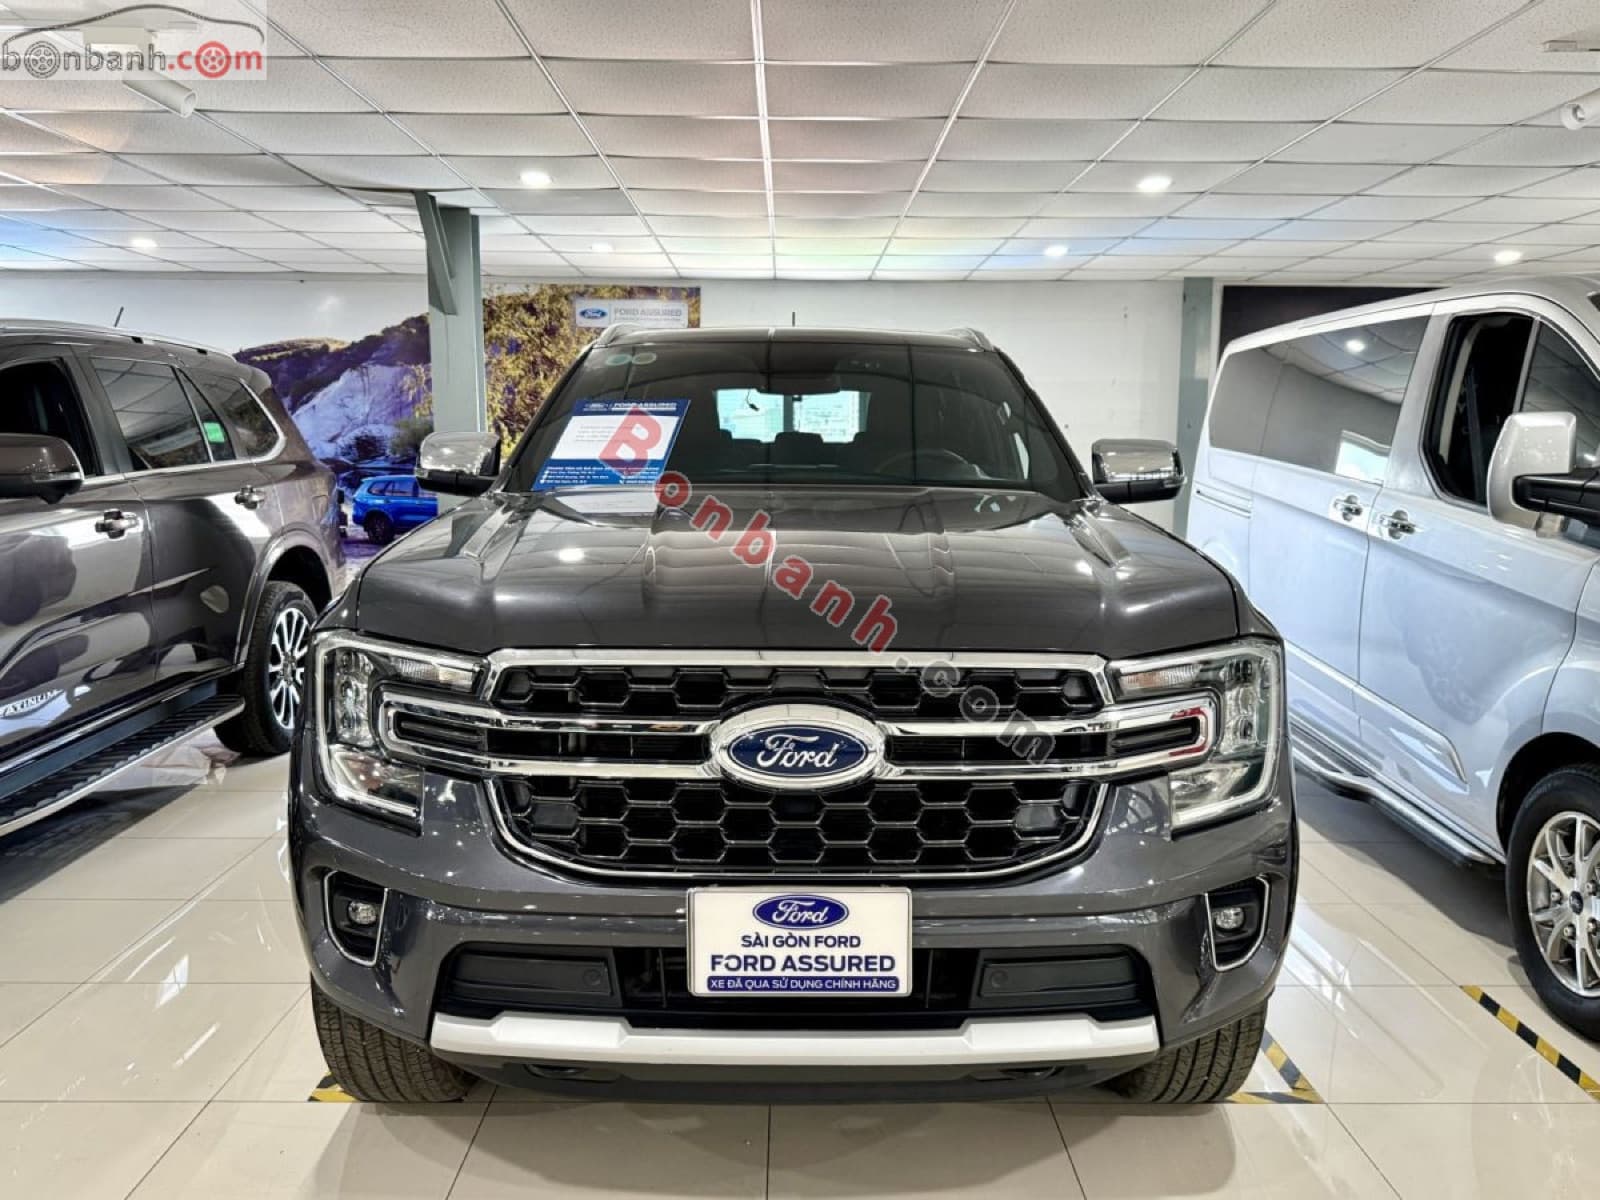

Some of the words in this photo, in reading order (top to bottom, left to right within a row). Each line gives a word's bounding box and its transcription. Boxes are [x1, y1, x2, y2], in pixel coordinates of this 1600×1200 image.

[0, 688, 64, 718] ATINUM
[756, 733, 840, 768] Ford
[771, 899, 829, 924] Ford
[741, 931, 768, 948] SÀI
[773, 931, 810, 948] GÒN
[814, 935, 861, 948] FORD
[710, 954, 776, 972] FORD
[781, 954, 896, 972] ASSURED
[710, 979, 725, 990] XE
[727, 977, 743, 990] ĐÃ
[744, 979, 770, 991] QUA
[772, 976, 788, 990] SỬ
[790, 979, 823, 992] DỤNG
[825, 977, 862, 990] CHÍNH
[865, 977, 897, 990] HÃNG
